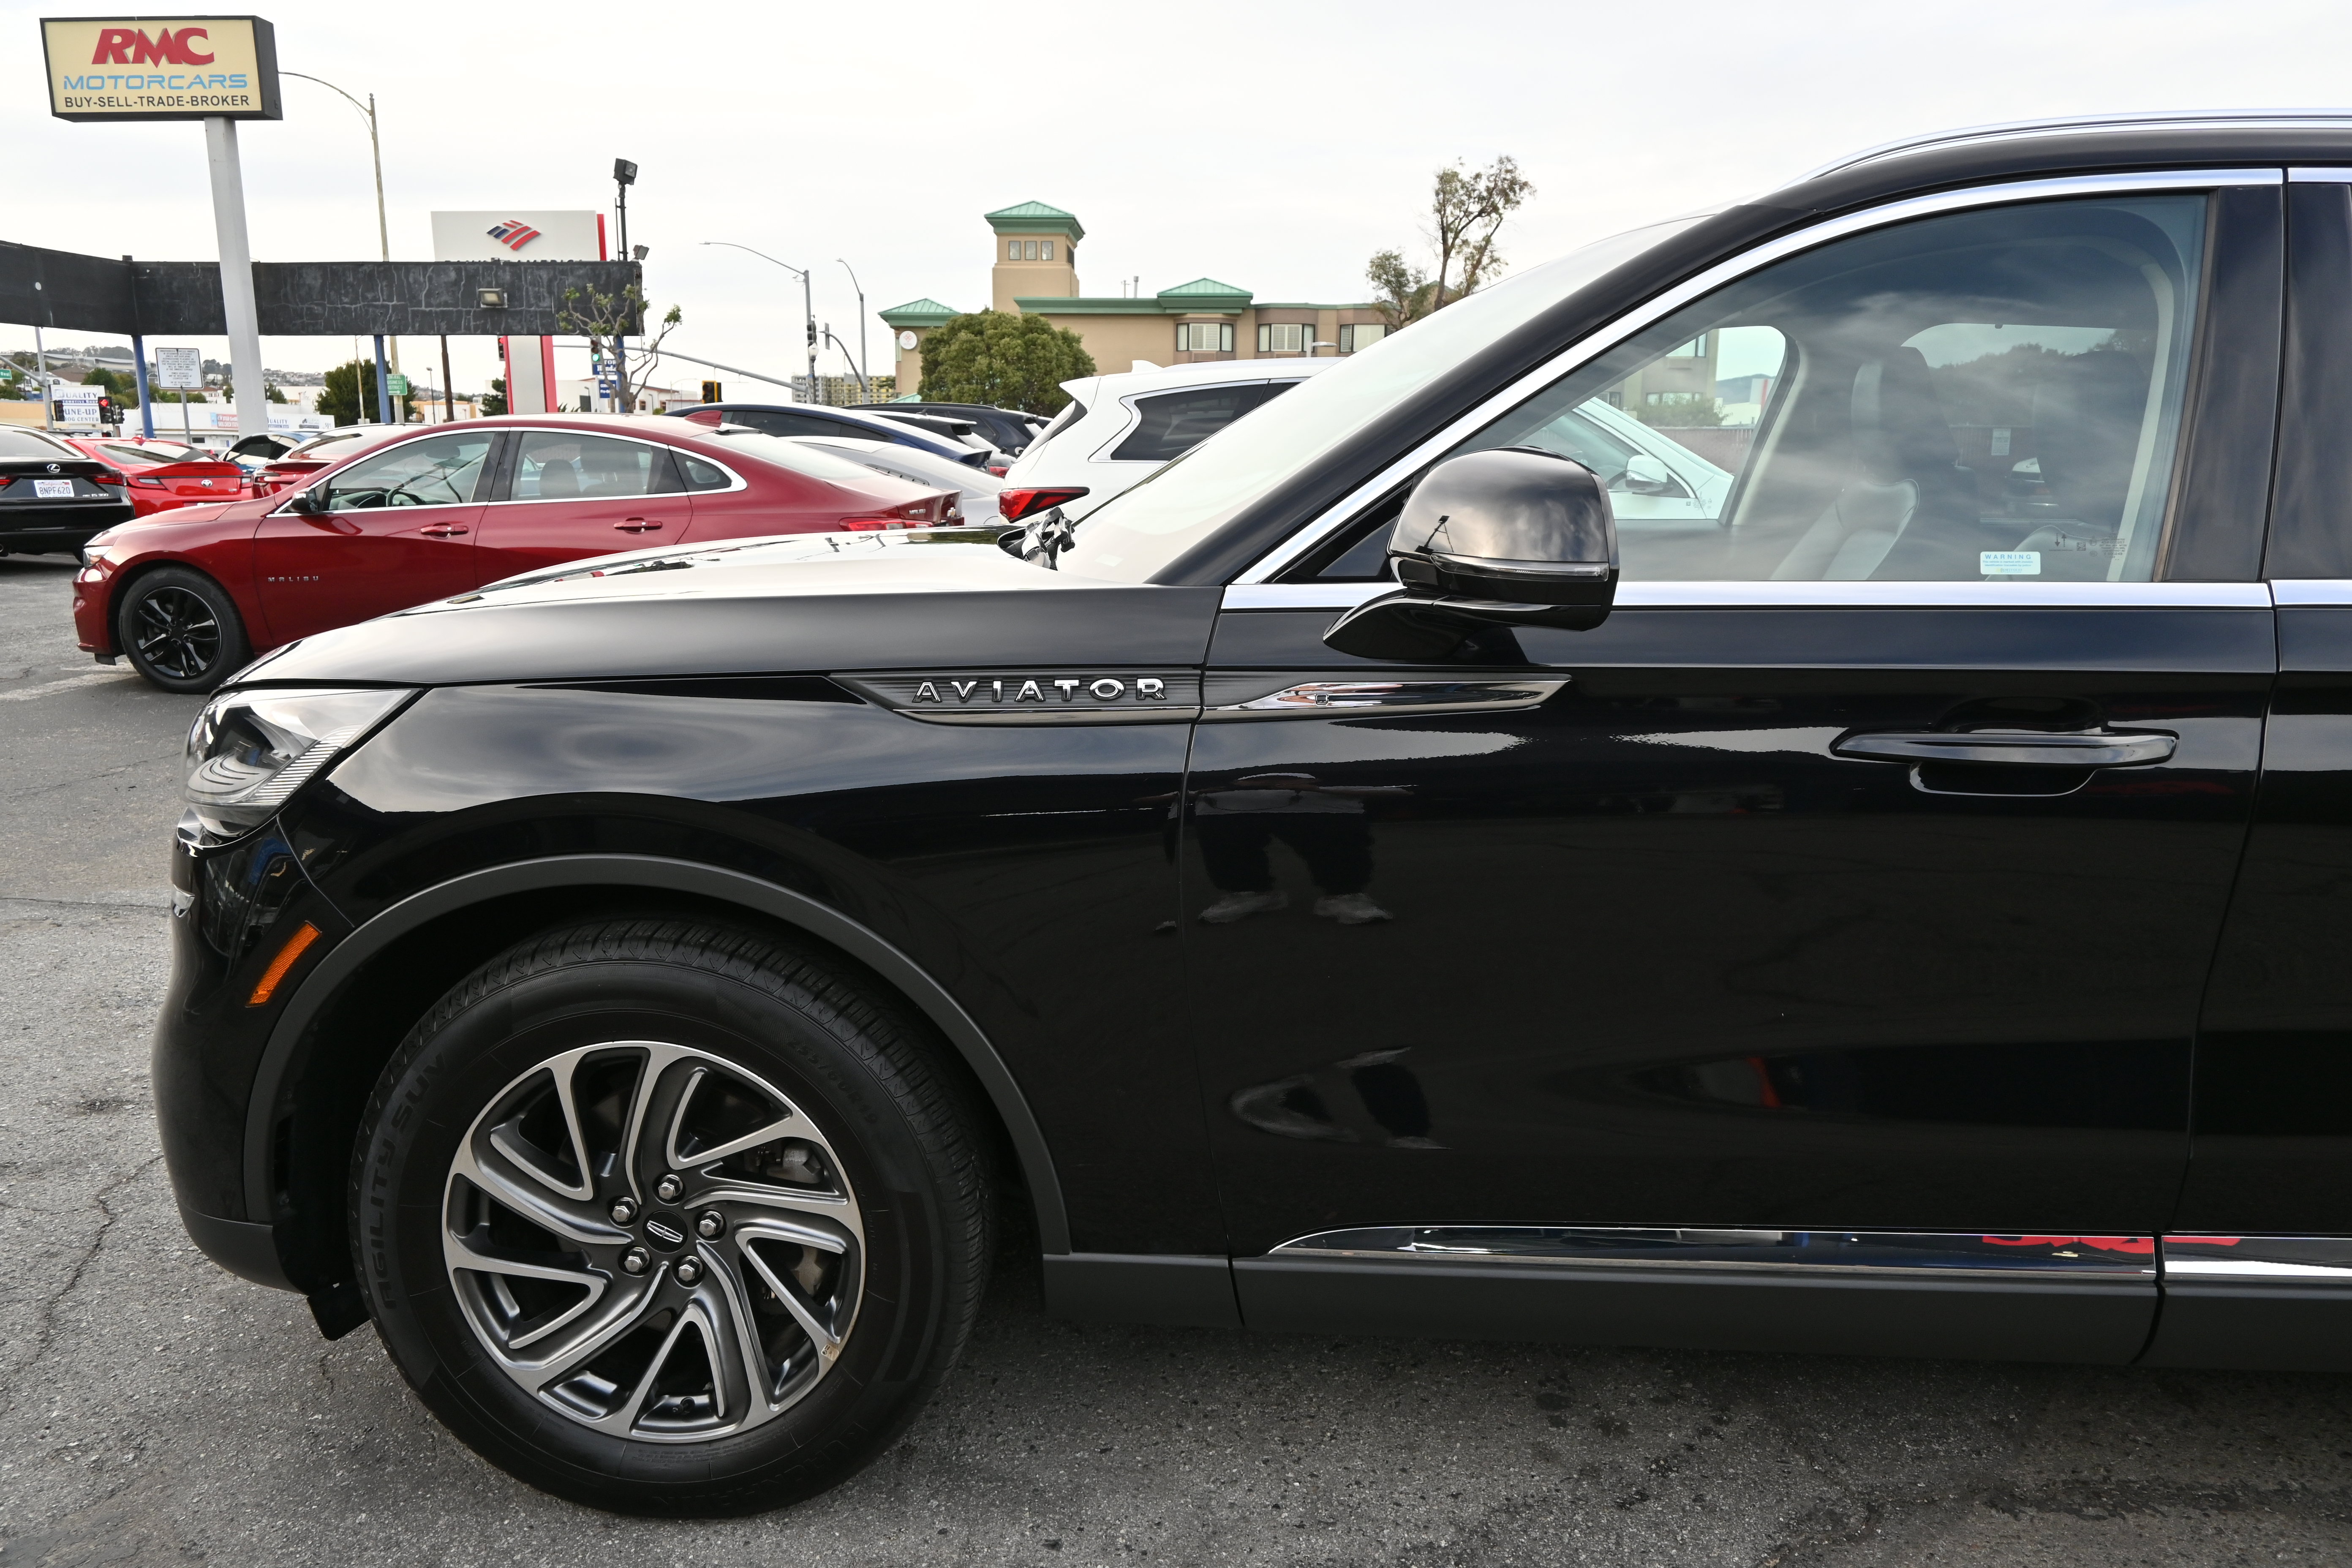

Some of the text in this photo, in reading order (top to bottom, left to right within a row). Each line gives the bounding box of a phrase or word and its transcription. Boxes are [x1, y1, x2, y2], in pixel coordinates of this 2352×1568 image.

[92, 27, 215, 68] RMC
[64, 74, 248, 90] MOTORCARS
[64, 95, 250, 108] BUY-SELL-TRADE-BROKER
[54, 389, 98, 398] QUALITY
[39, 487, 71, 495] 8NPF620
[912, 678, 1167, 703] AVIATOR
[369, 1051, 445, 1310] AGILITY SUV
